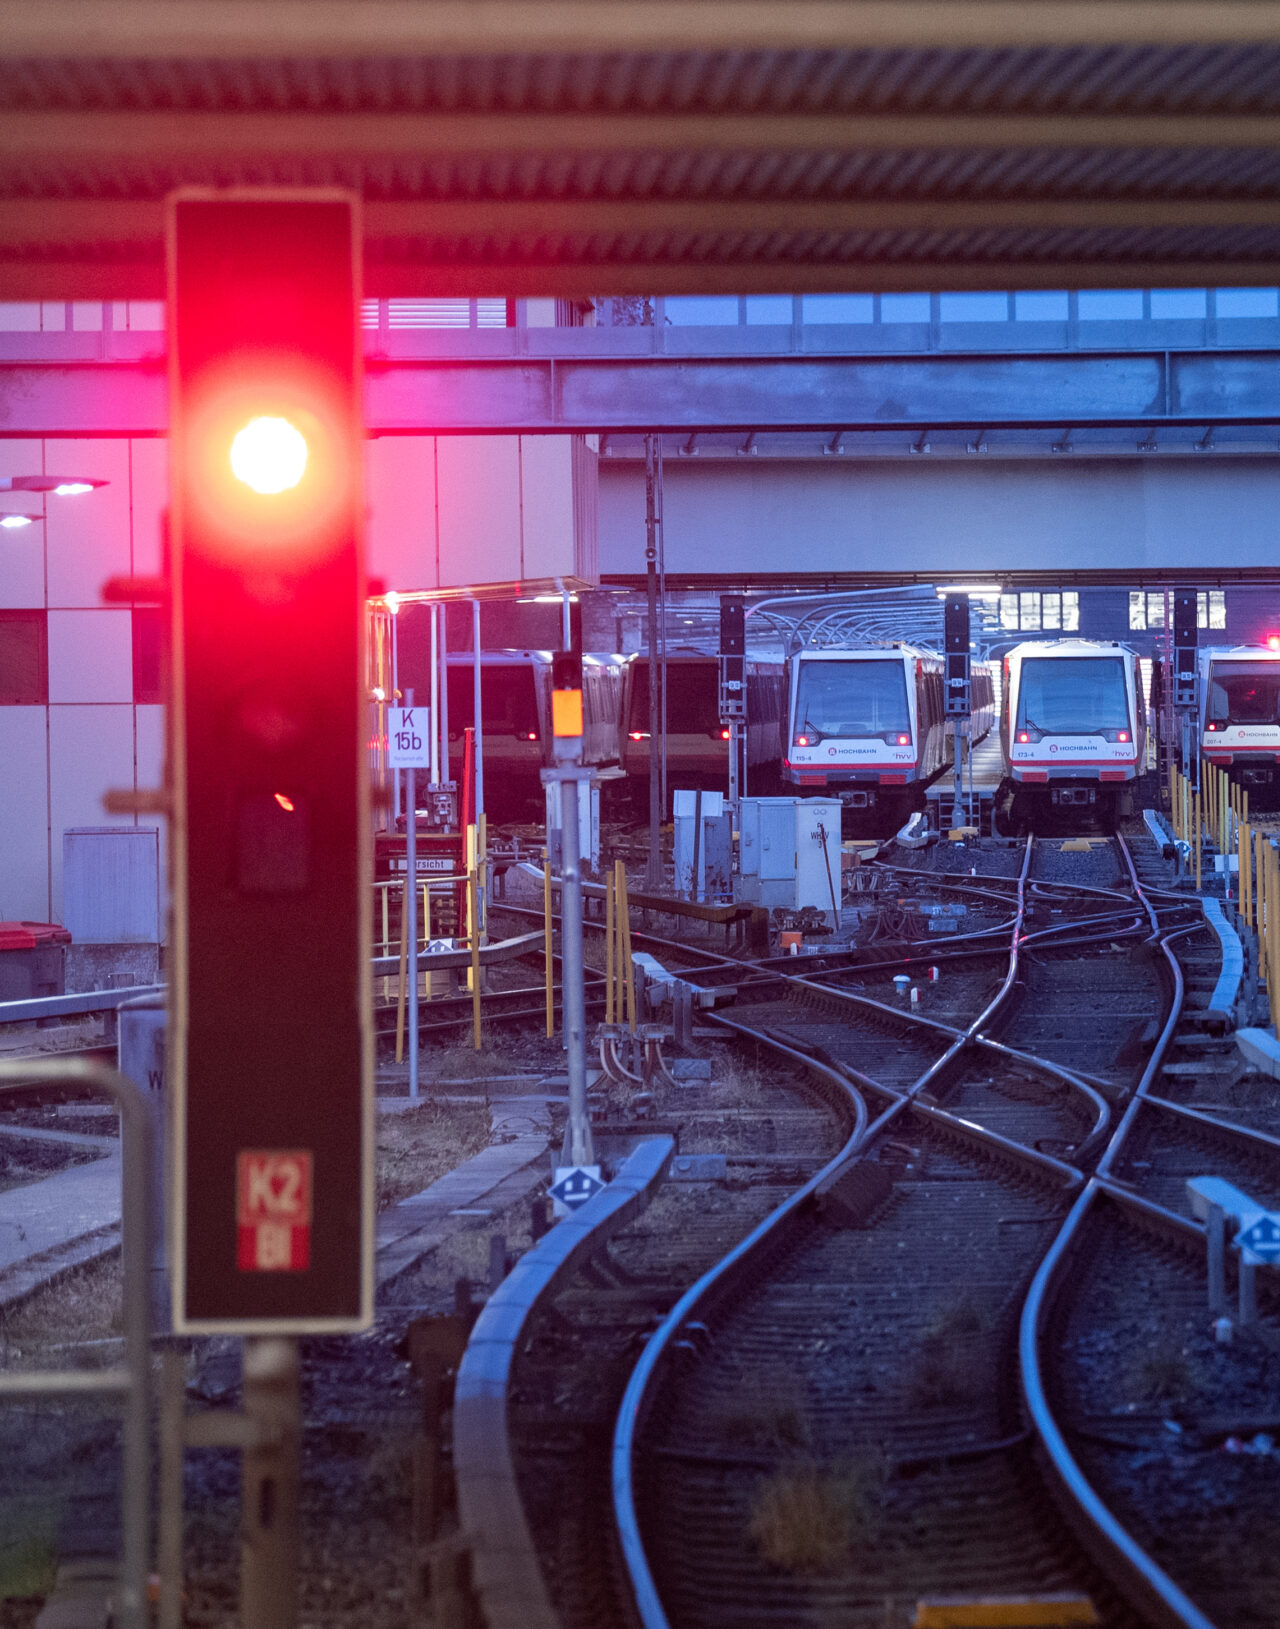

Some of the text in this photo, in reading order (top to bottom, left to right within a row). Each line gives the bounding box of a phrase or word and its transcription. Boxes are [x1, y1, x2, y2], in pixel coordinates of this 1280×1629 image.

[402, 709, 414, 728] K
[394, 731, 422, 751] 15b
[810, 831, 830, 840] WHV
[248, 1160, 300, 1211] K2
